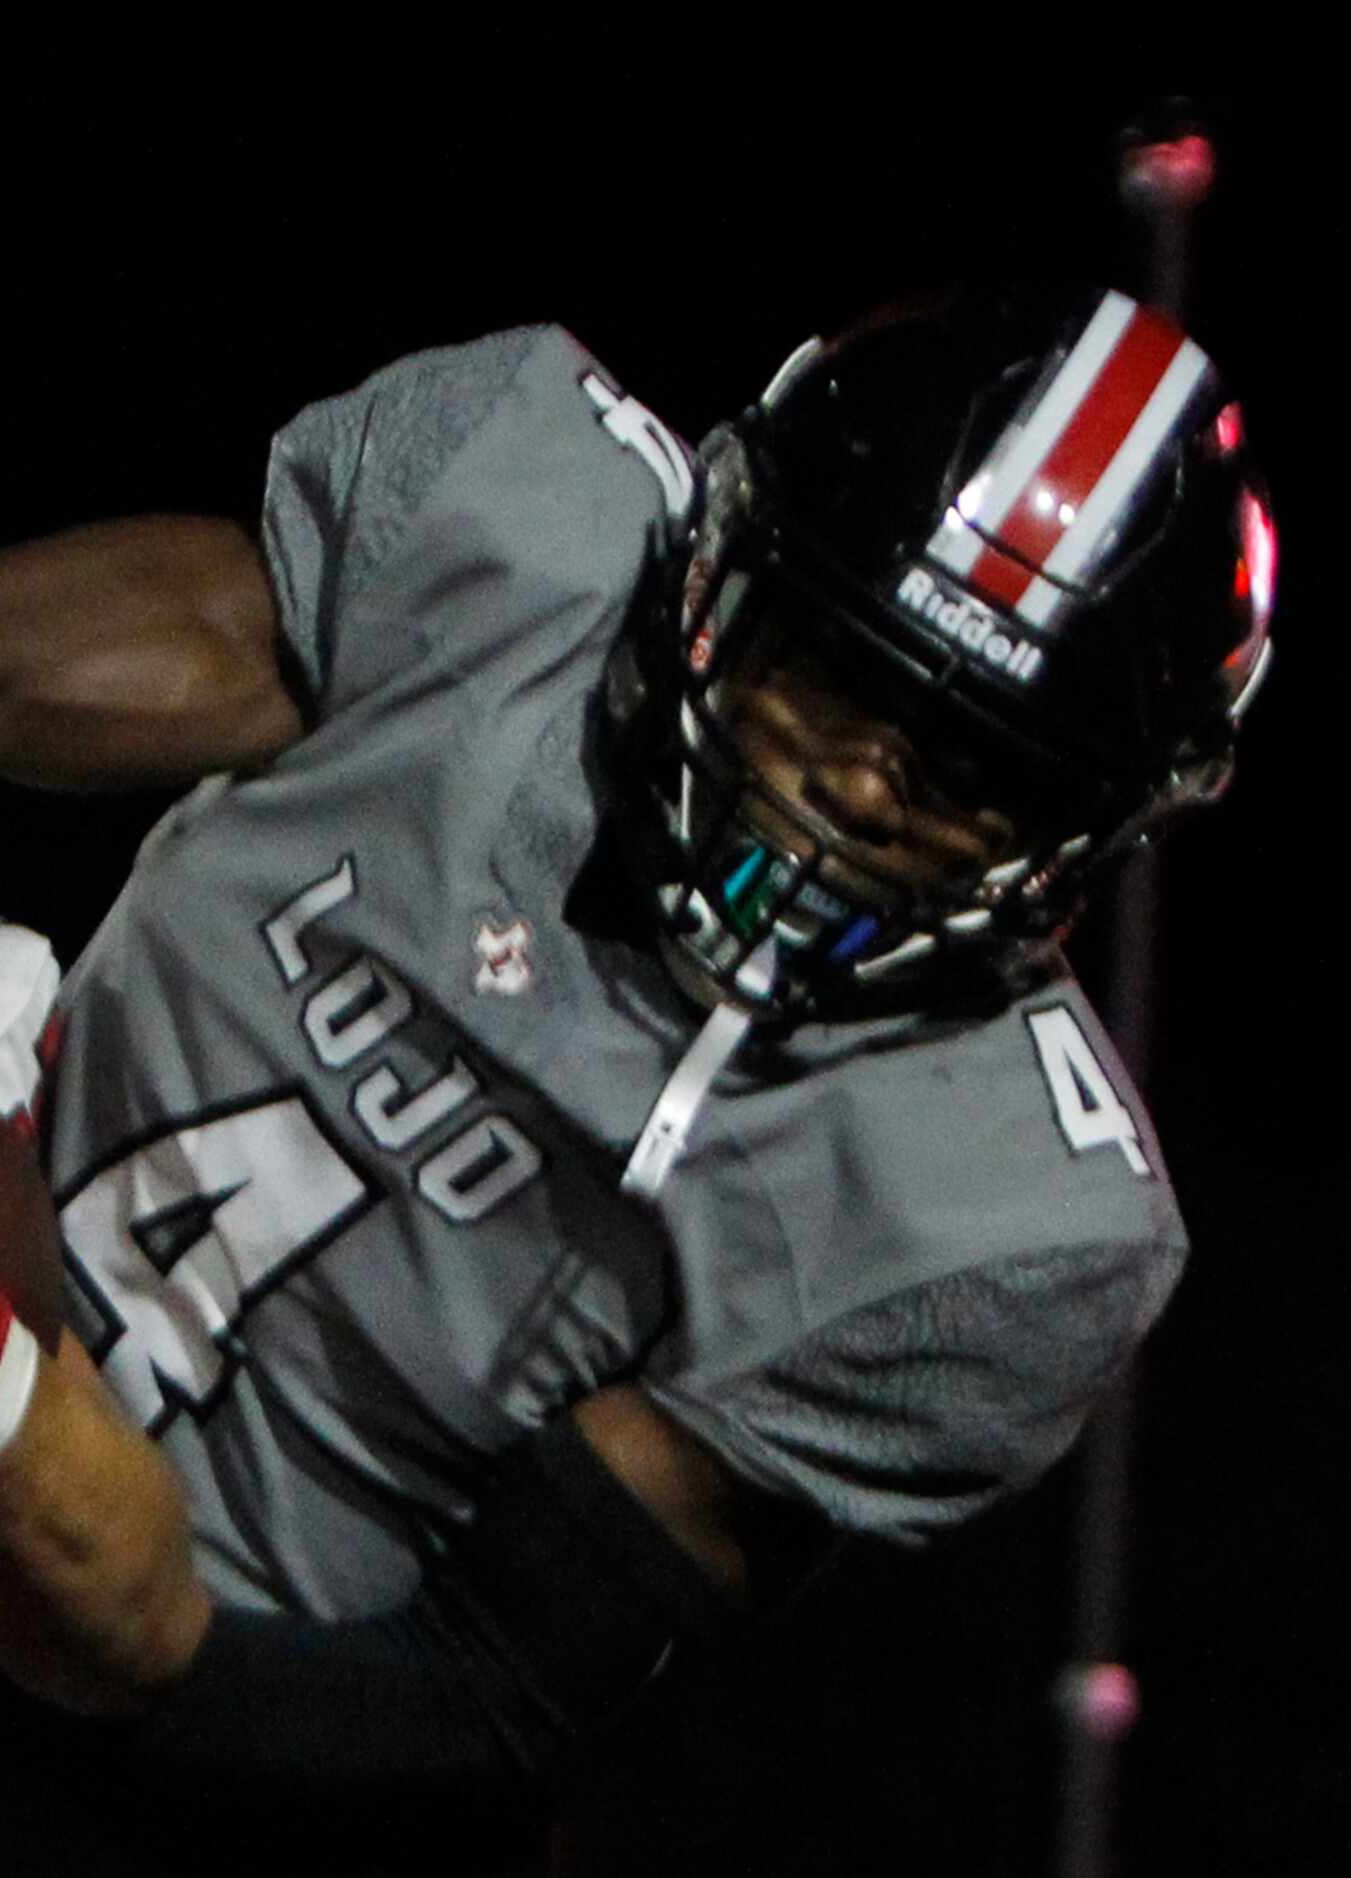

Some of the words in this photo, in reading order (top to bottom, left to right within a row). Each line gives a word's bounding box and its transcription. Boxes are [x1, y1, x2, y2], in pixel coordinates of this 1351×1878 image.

[895, 567, 1044, 684] Riddell
[262, 855, 547, 1226] LOJO
[1026, 1004, 1152, 1178] 4
[58, 1086, 384, 1440] 4
